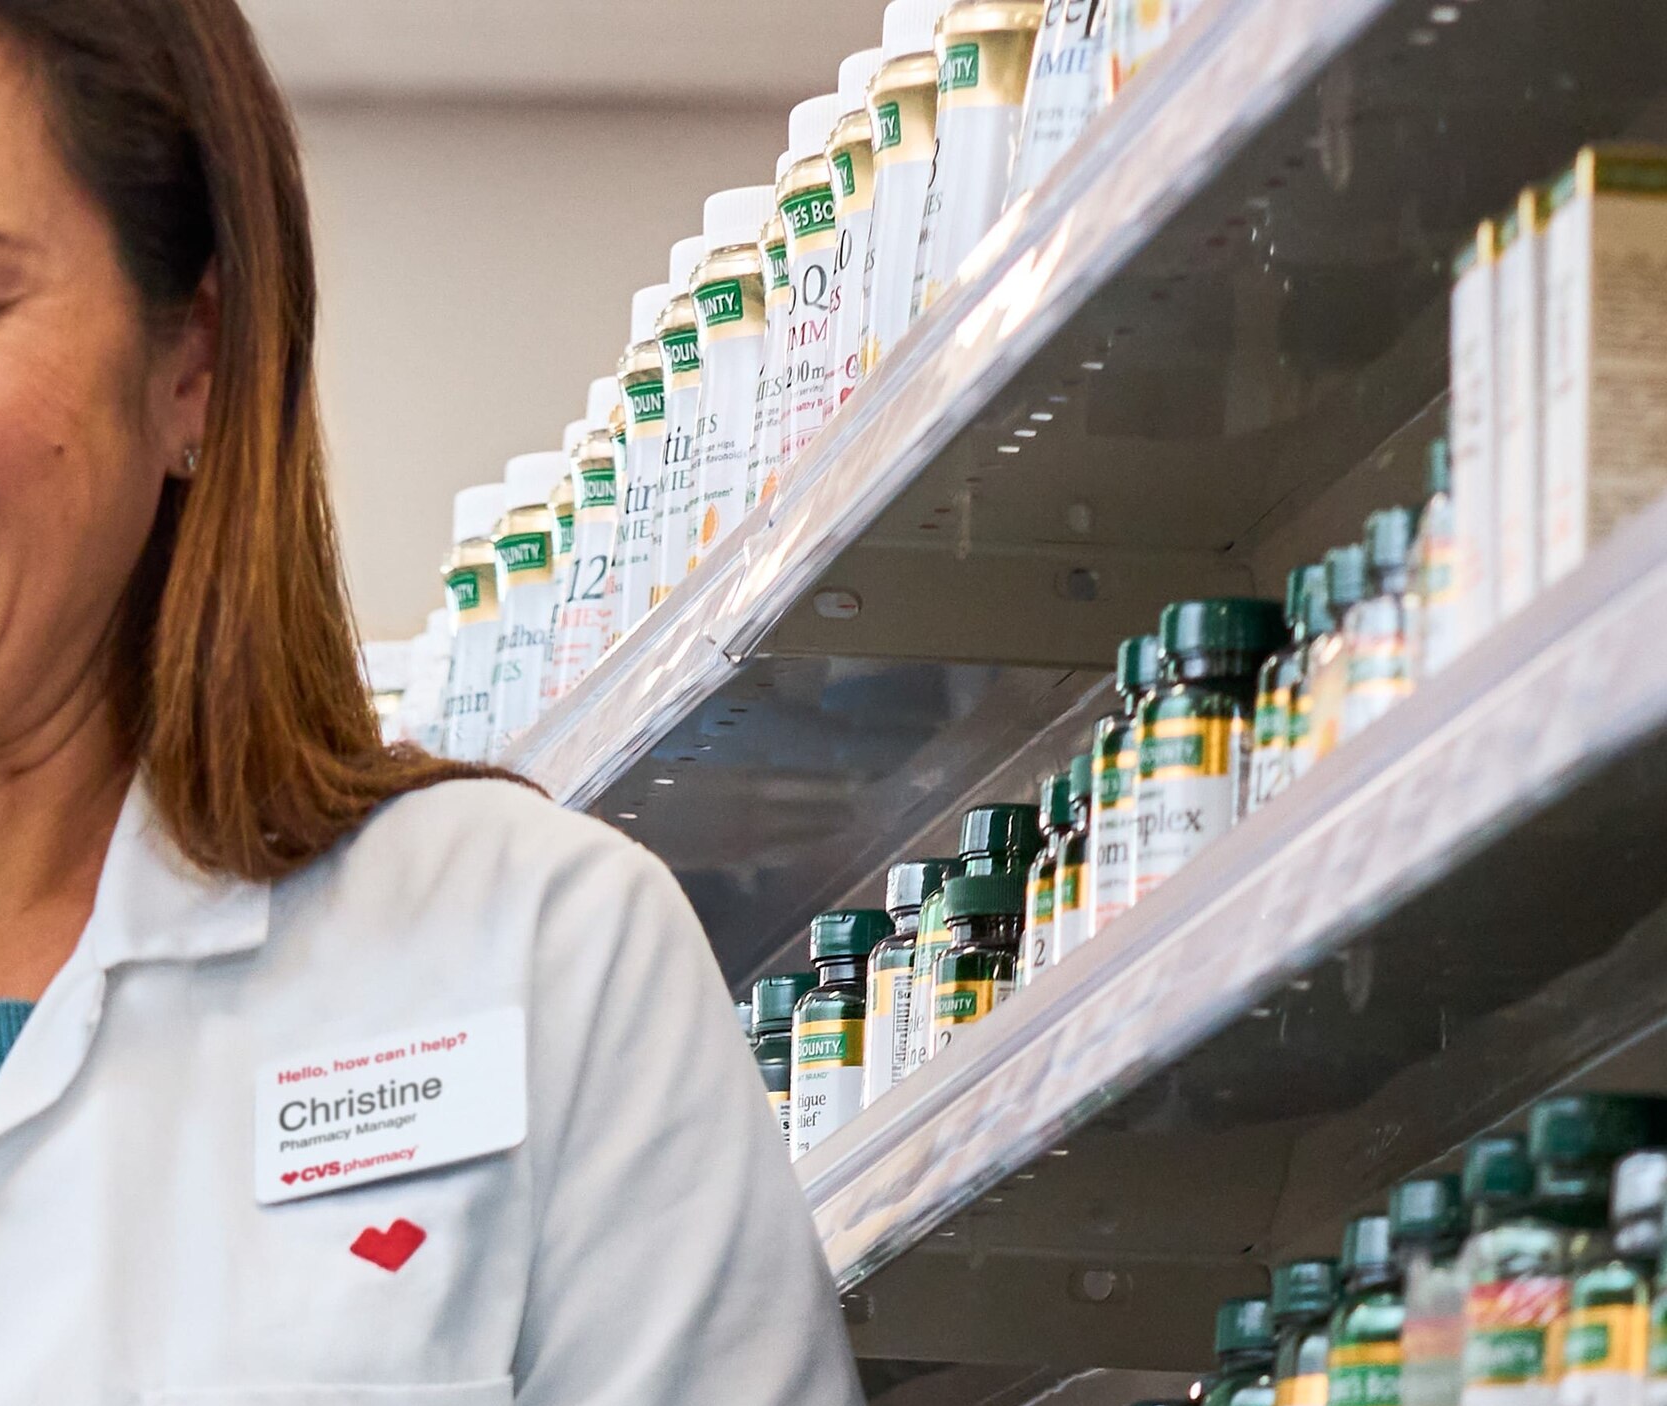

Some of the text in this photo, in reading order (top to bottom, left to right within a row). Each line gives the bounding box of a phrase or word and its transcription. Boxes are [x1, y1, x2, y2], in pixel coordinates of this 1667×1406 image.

[277, 1065, 328, 1085] Hello,
[333, 1056, 370, 1072] how
[374, 1048, 406, 1064] can
[420, 1031, 468, 1053] help?
[278, 1076, 443, 1132] Christine
[279, 1112, 418, 1153] Pharmacy Manager
[300, 1147, 416, 1182] CVS pharmacy
